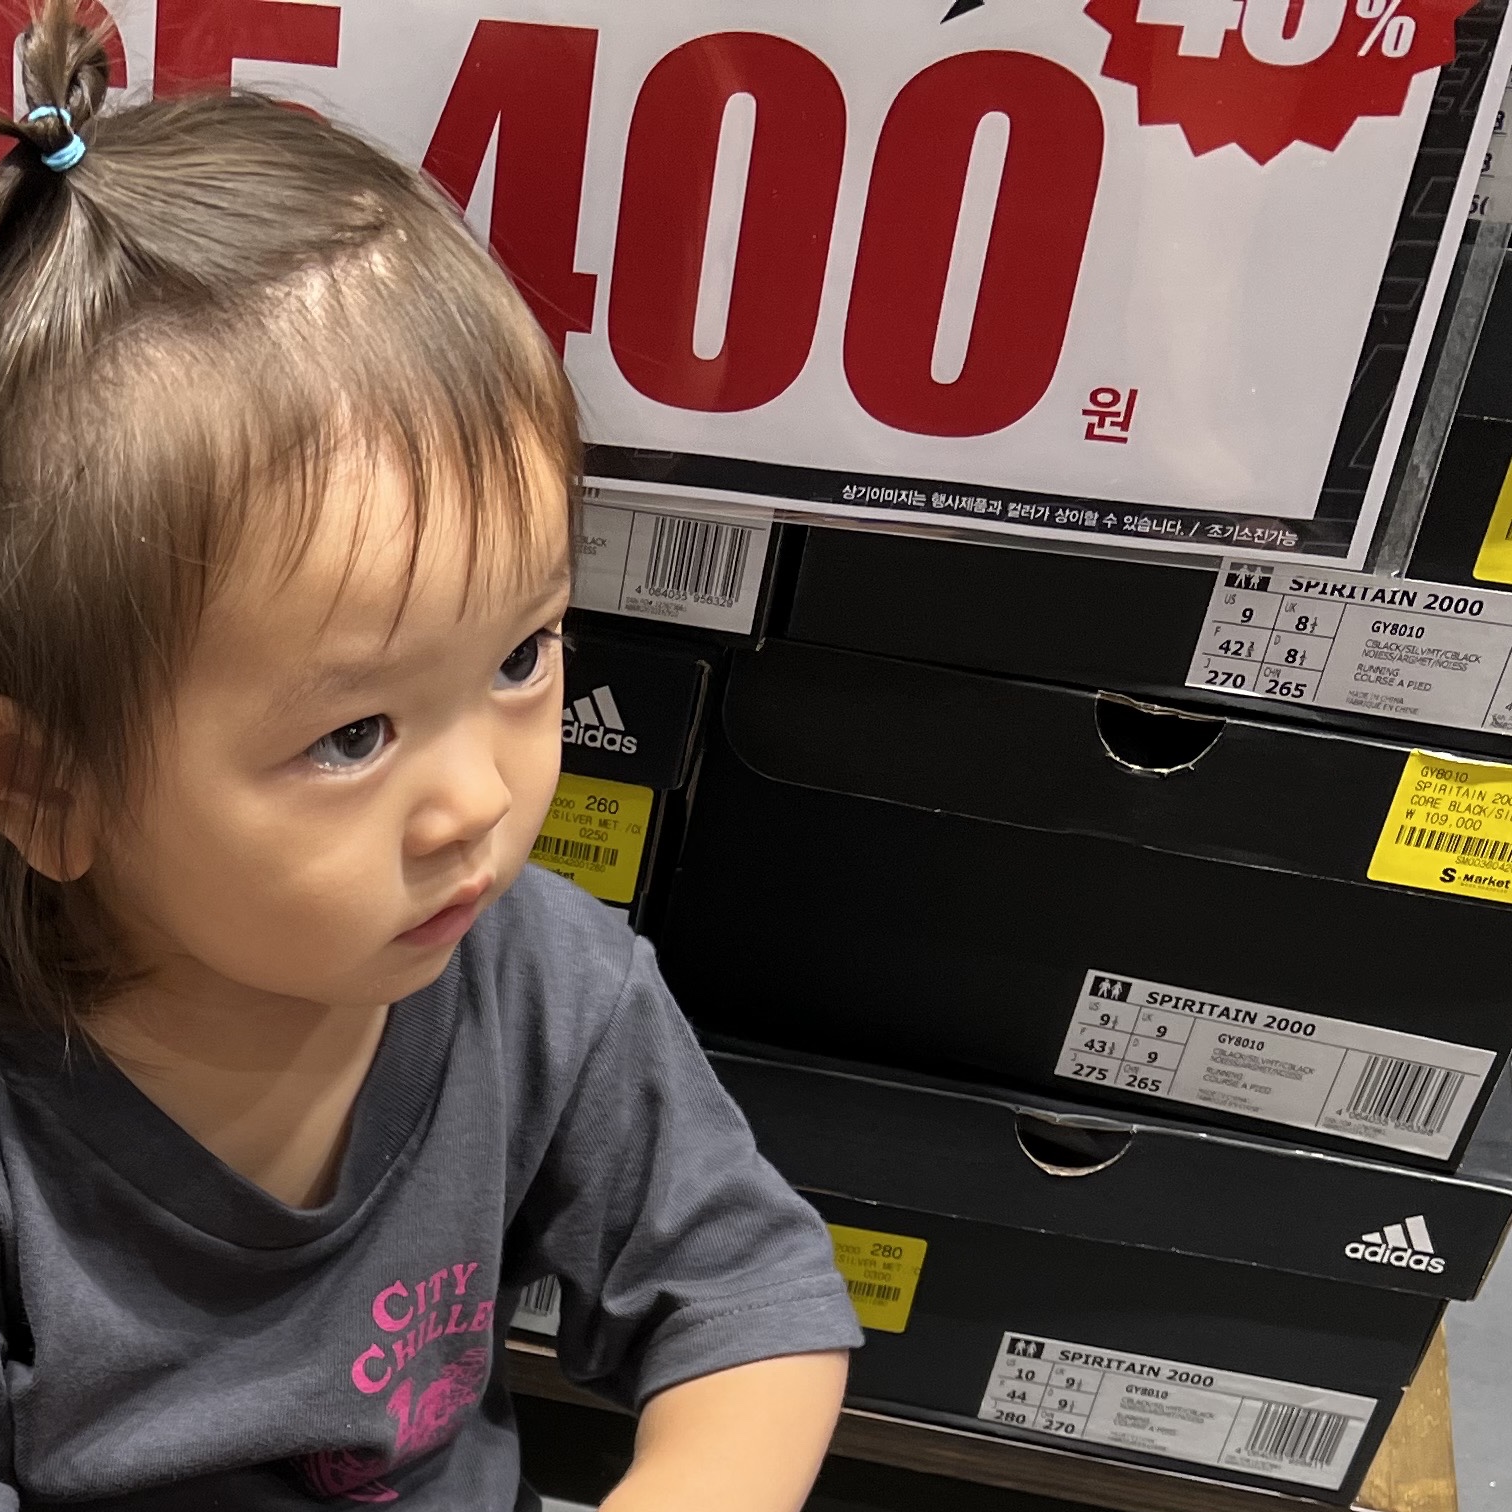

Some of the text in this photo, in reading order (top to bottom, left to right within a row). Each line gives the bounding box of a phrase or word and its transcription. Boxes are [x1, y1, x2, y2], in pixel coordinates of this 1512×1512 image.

[1082, 387, 1138, 444] 원
[842, 484, 927, 507] 상기이미지는
[931, 492, 1003, 515] 행사제품과
[1007, 502, 1050, 522] 컬러가
[1054, 507, 1099, 528] 상이할
[1102, 513, 1118, 529] 수
[1123, 515, 1185, 537] 있습니다.
[1205, 523, 1299, 547] 조기소진가능
[1224, 592, 1297, 613] US UK
[1288, 576, 1484, 617] SPIRITAIN 2000
[1240, 608, 1254, 624] 9
[1214, 626, 1221, 636] F
[1371, 620, 1425, 639] GY8010
[1357, 663, 1400, 678] RUNNING
[1205, 669, 1307, 699] 270 265
[1354, 672, 1432, 692] COURSE A PIED
[561, 720, 638, 755] didas
[1420, 765, 1469, 783] GY8010
[1414, 780, 1487, 802] SPIRITAIN
[585, 795, 619, 815] 260
[1410, 794, 1443, 810] CORE
[598, 819, 619, 831] MET
[1425, 811, 1482, 832] 109,000
[579, 827, 609, 842] 0250
[1145, 991, 1317, 1037] SPIRITAIN 2000
[1156, 1025, 1168, 1038] 9
[1217, 1033, 1265, 1051] GY8010
[1146, 1051, 1158, 1064] 9
[1072, 1063, 1162, 1092] 275 265
[870, 1243, 904, 1260] 280
[1344, 1242, 1446, 1275] adidas
[372, 1262, 479, 1333] CITY
[1015, 1368, 1036, 1381] 10
[1058, 1350, 1215, 1388] SPIRITAIN 2000
[1006, 1389, 1027, 1403] 44
[1125, 1384, 1169, 1400] GY8010
[994, 1409, 1076, 1435] 280 270
